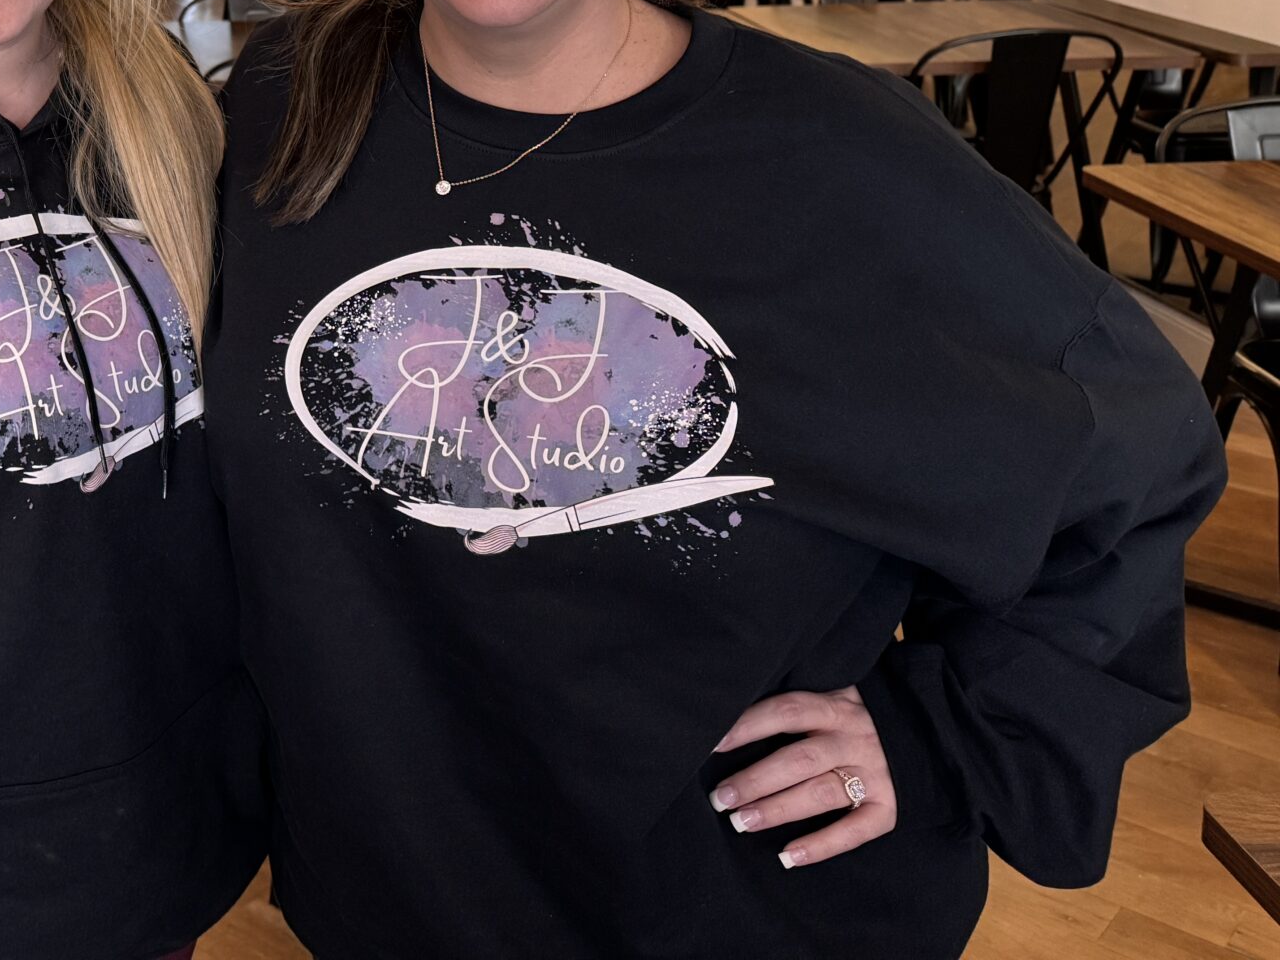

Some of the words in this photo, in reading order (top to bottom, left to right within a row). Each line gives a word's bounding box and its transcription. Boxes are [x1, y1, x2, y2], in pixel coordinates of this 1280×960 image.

[61, 324, 182, 429] Studo
[397, 274, 625, 403] J&J
[346, 367, 473, 477] Art
[483, 364, 626, 493] Studio
